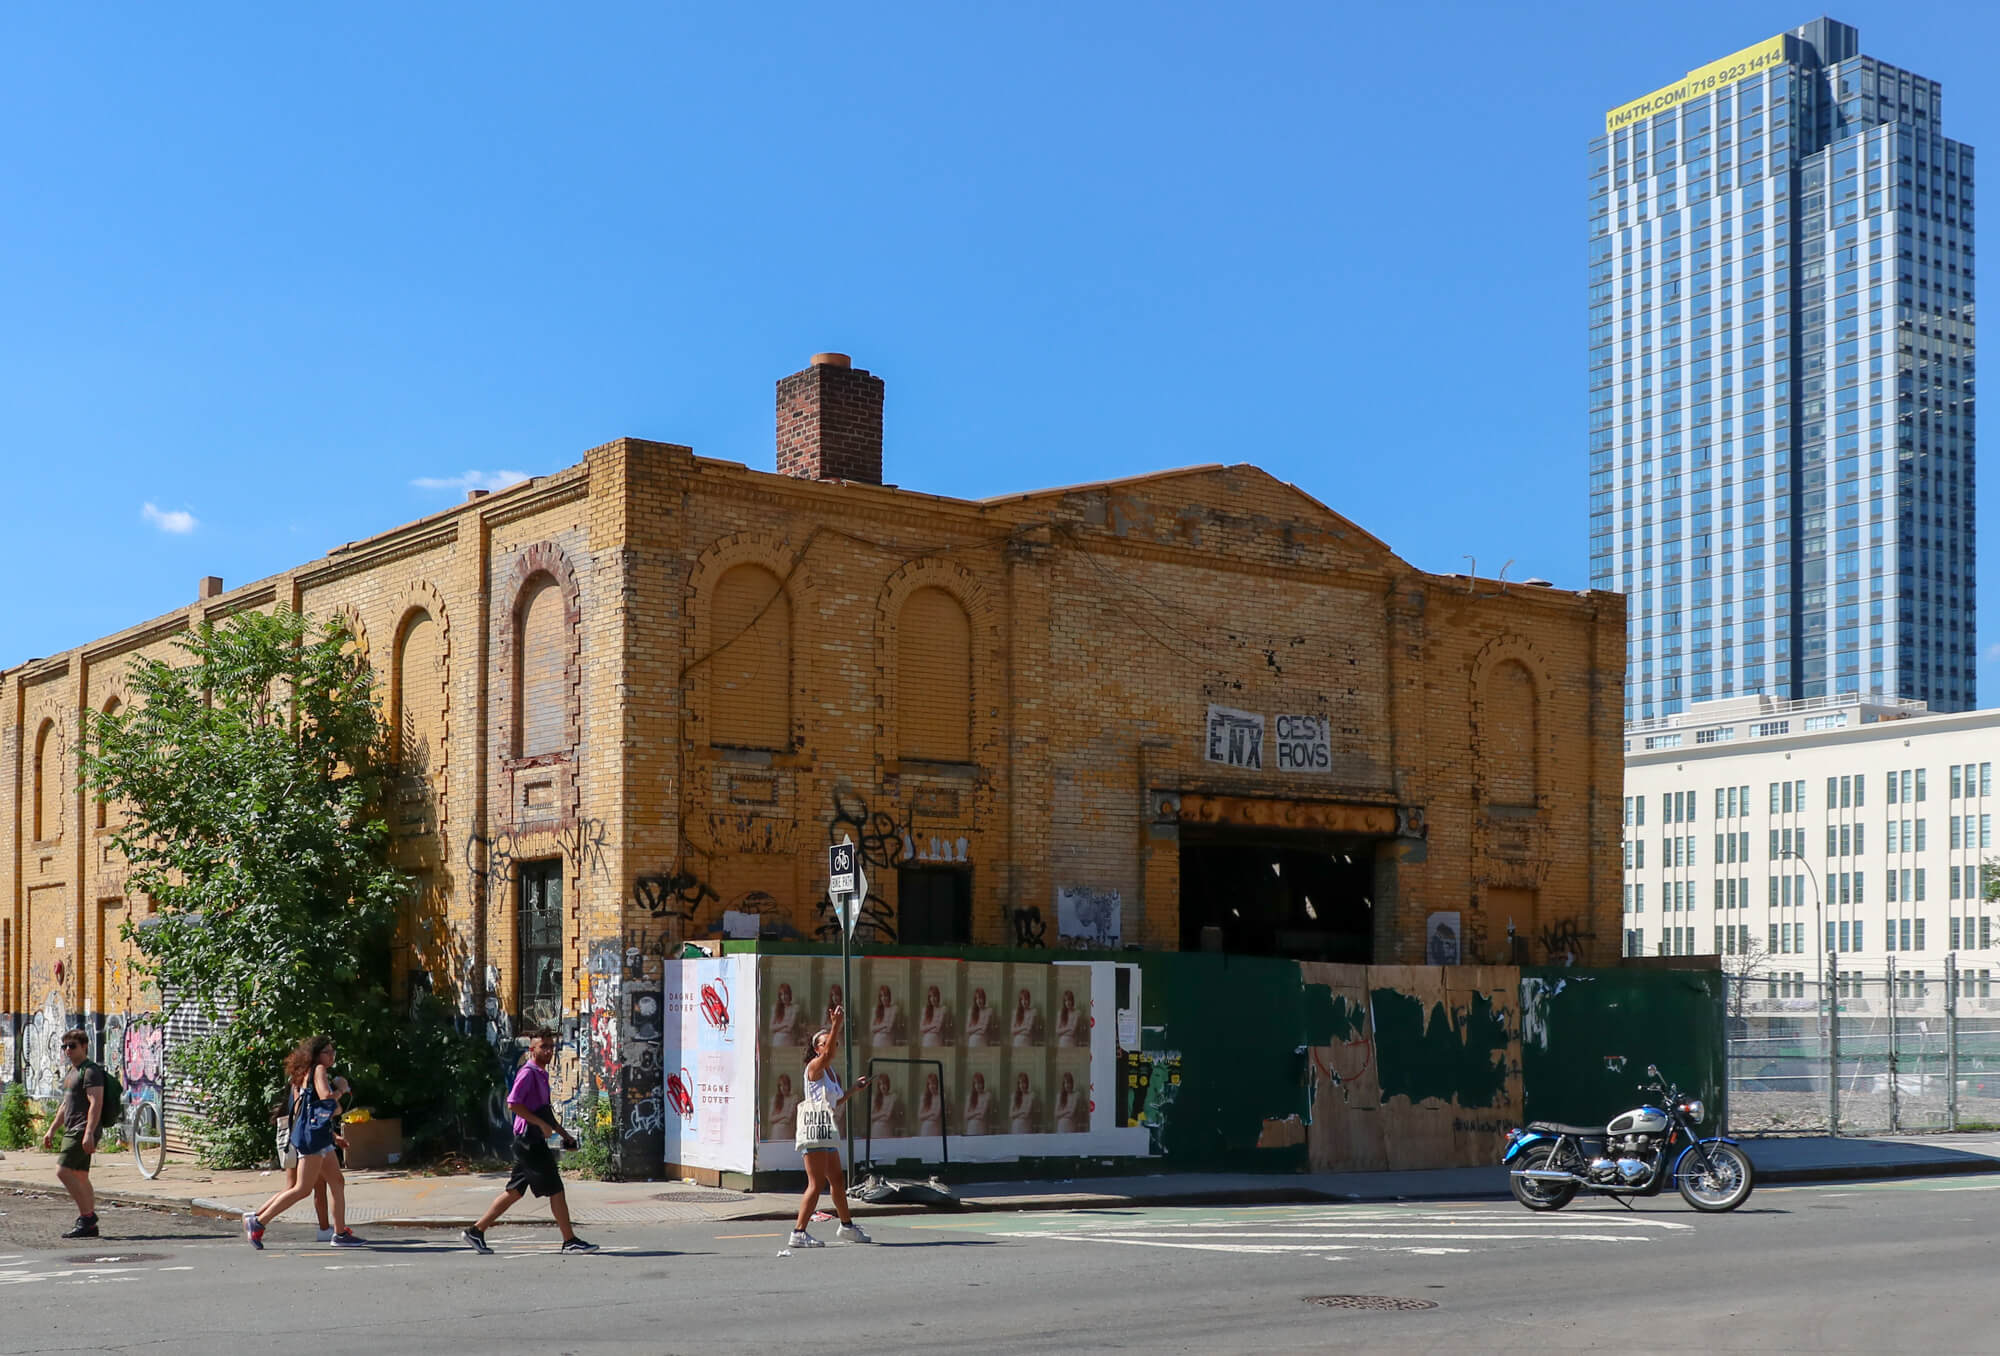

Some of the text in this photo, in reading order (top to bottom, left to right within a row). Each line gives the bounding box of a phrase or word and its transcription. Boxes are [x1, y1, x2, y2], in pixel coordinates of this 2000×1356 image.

[1608, 48, 1781, 128] 1N4TH.COM 718 923 1414
[832, 877, 841, 889] BIKE
[669, 993, 694, 1001] DAGNE
[669, 1004, 694, 1012] DOVER
[702, 1084, 729, 1093] DAGNE
[702, 1095, 729, 1104] DOVER
[804, 1110, 832, 1125] CALLEN
